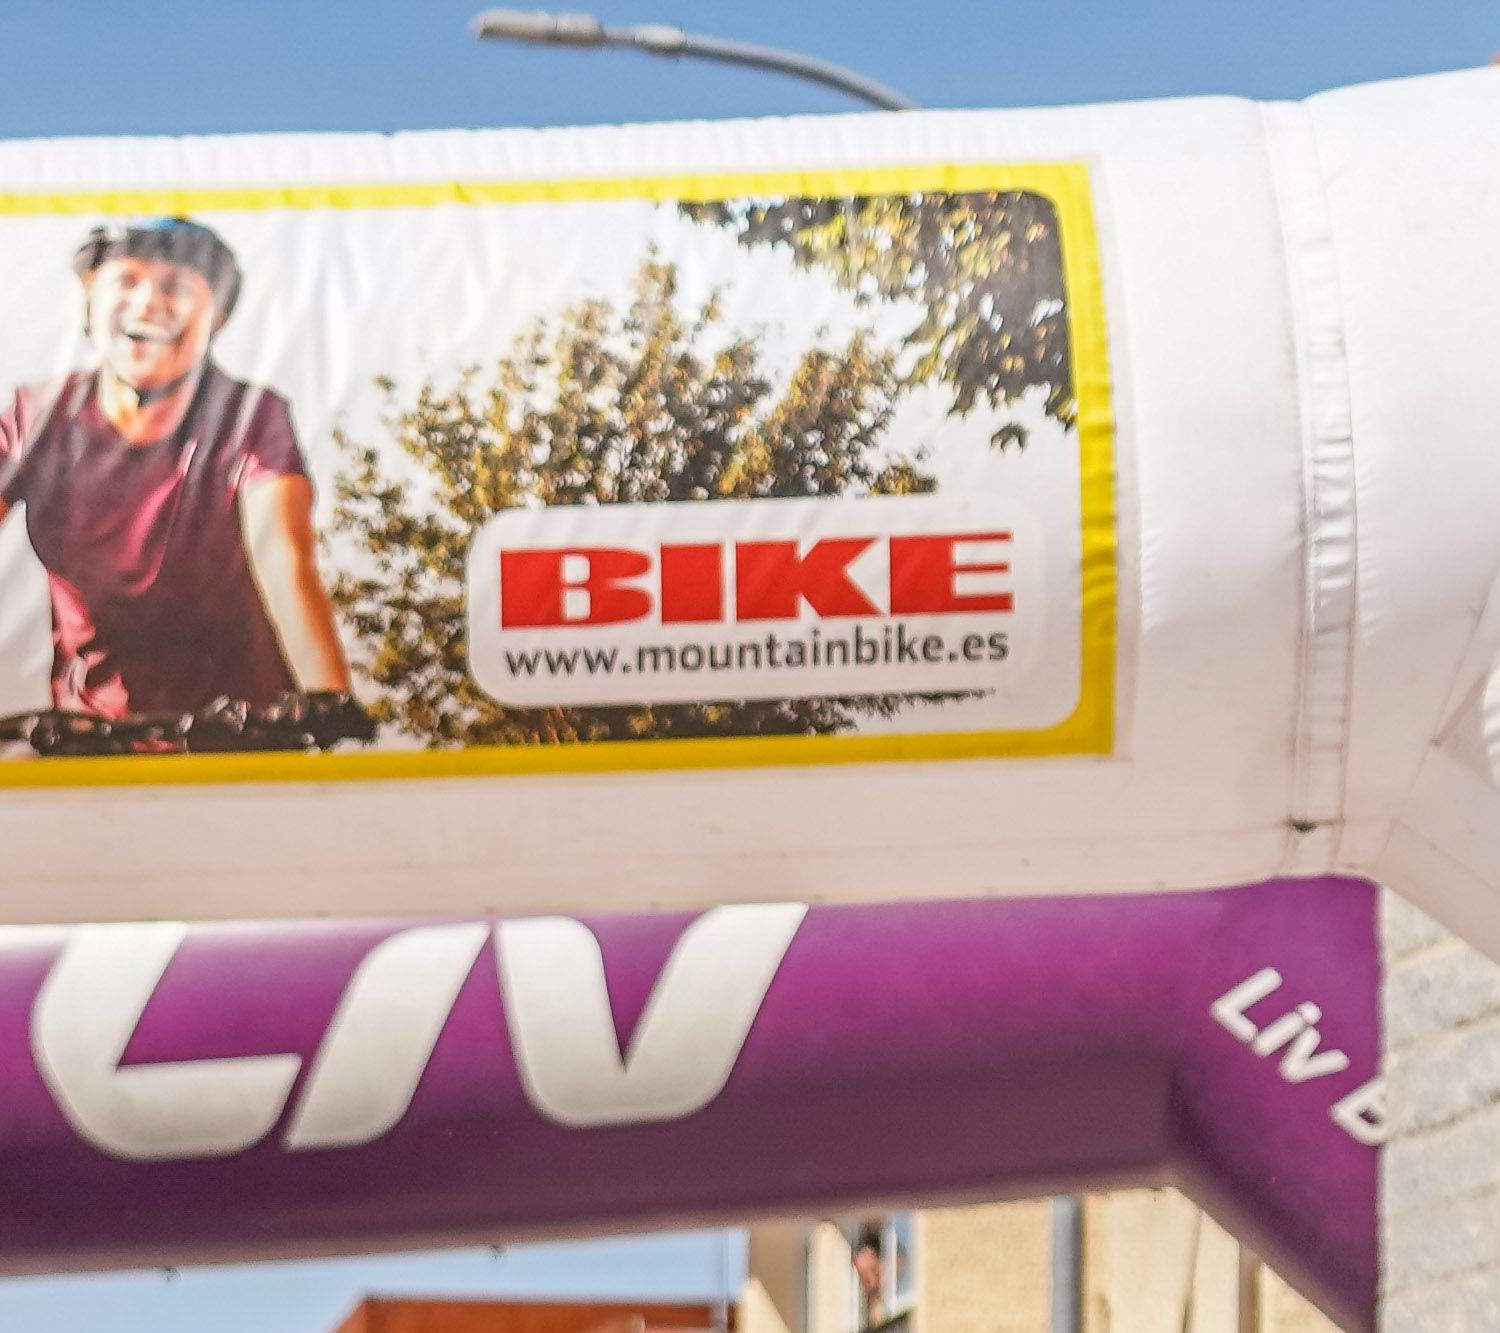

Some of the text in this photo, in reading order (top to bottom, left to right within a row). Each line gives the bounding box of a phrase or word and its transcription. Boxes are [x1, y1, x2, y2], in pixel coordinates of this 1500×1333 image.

[501, 531, 1014, 630] BIKE
[504, 626, 1010, 678] www.mountainbike.es
[1211, 966, 1350, 1083] Liv
